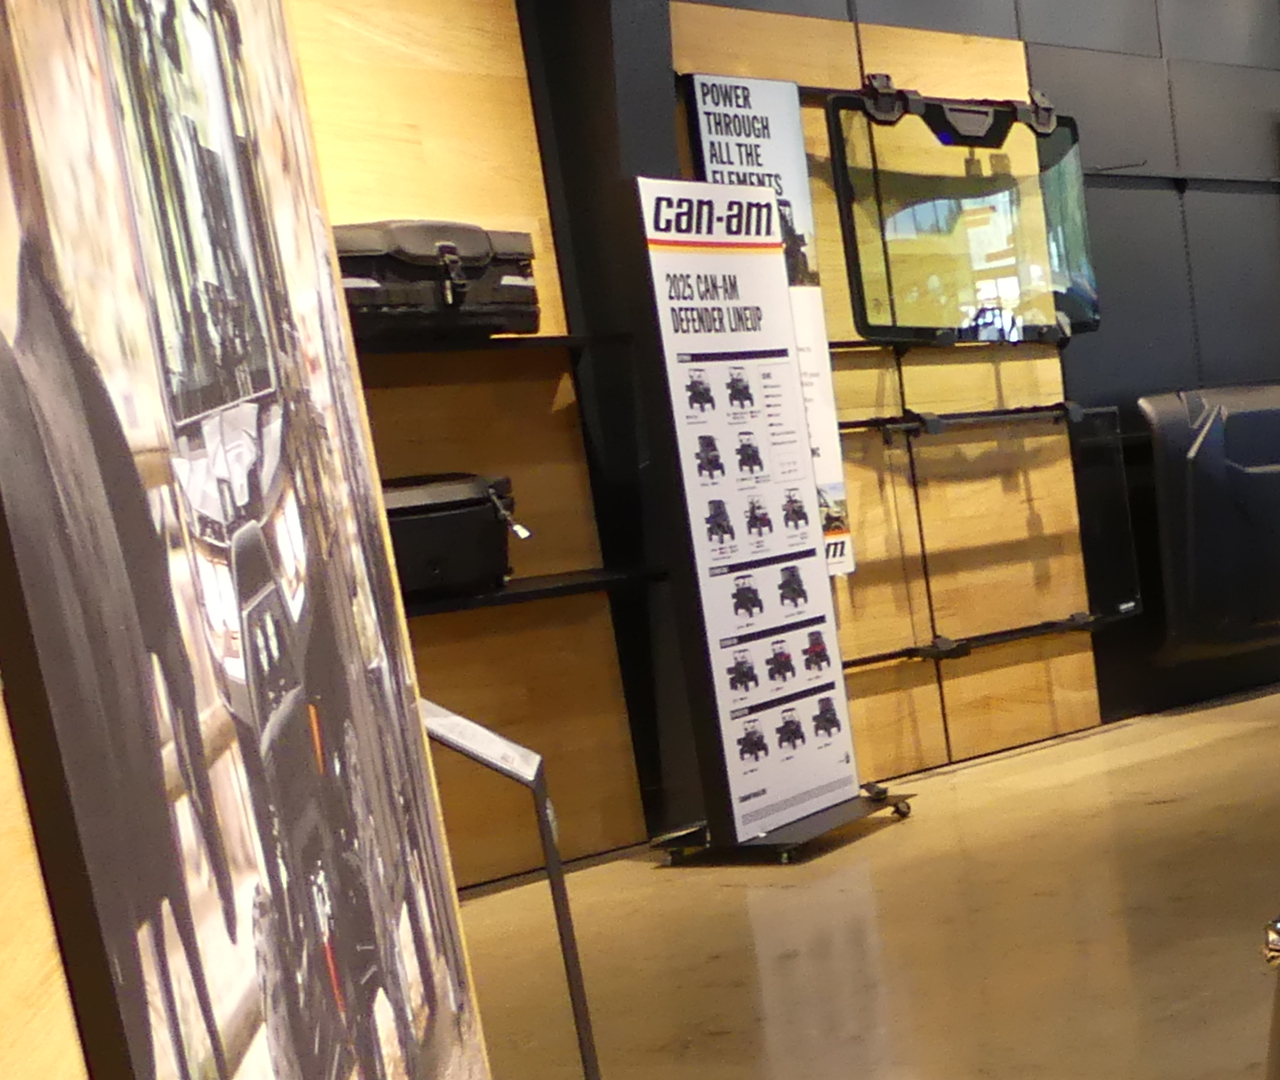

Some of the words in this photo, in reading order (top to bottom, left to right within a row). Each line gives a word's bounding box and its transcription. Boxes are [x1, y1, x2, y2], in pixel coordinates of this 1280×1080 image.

[701, 82, 752, 110] POWER
[704, 111, 770, 140] THROUGH
[709, 141, 734, 165] ALL
[735, 143, 763, 167] THE
[711, 170, 783, 196] ELEMENTS
[653, 196, 772, 236] can-am
[665, 273, 695, 301] 2025
[696, 273, 740, 301] CAN-AM
[670, 306, 727, 334] DEFENDER
[726, 305, 763, 333] LINEUP
